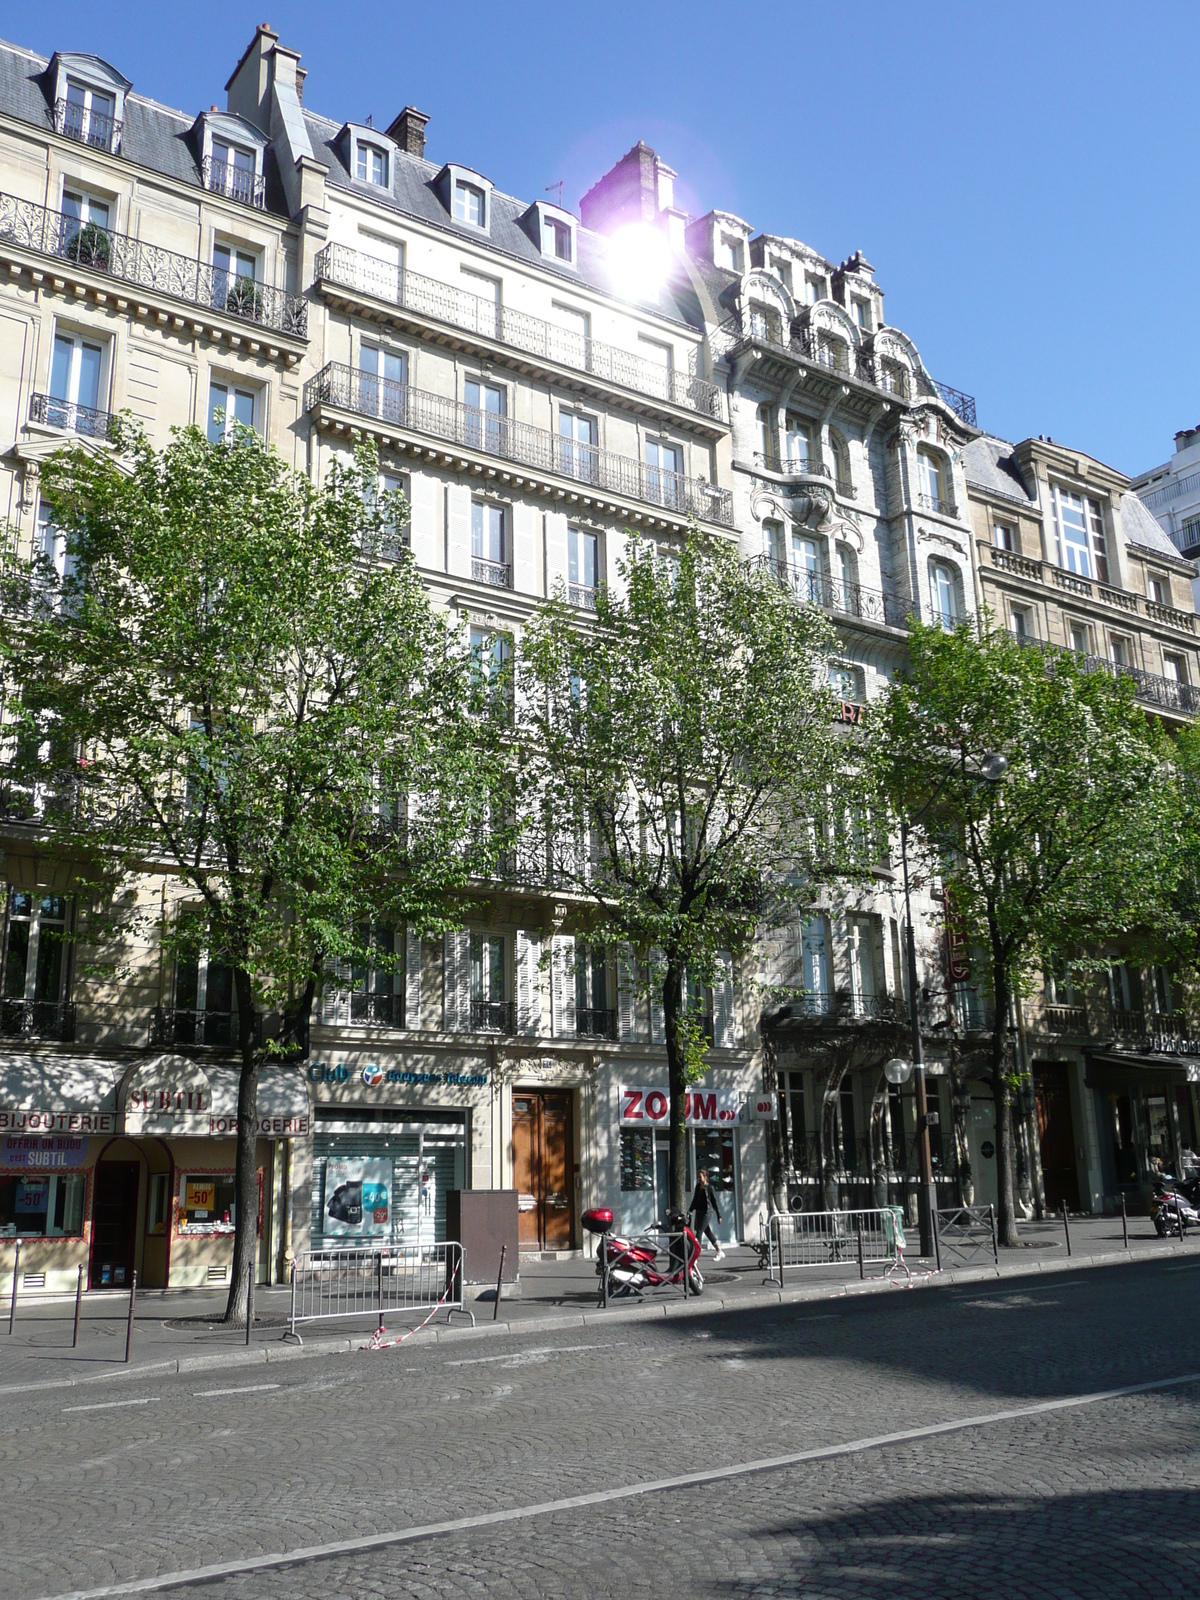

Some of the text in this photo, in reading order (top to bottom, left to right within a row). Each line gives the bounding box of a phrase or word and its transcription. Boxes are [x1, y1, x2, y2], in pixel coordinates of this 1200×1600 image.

[309, 1062, 350, 1083] Club
[130, 1090, 208, 1110] SUBTIL
[0, 1113, 111, 1130] BIJOUTERIE
[41, 1139, 54, 1150] UN
